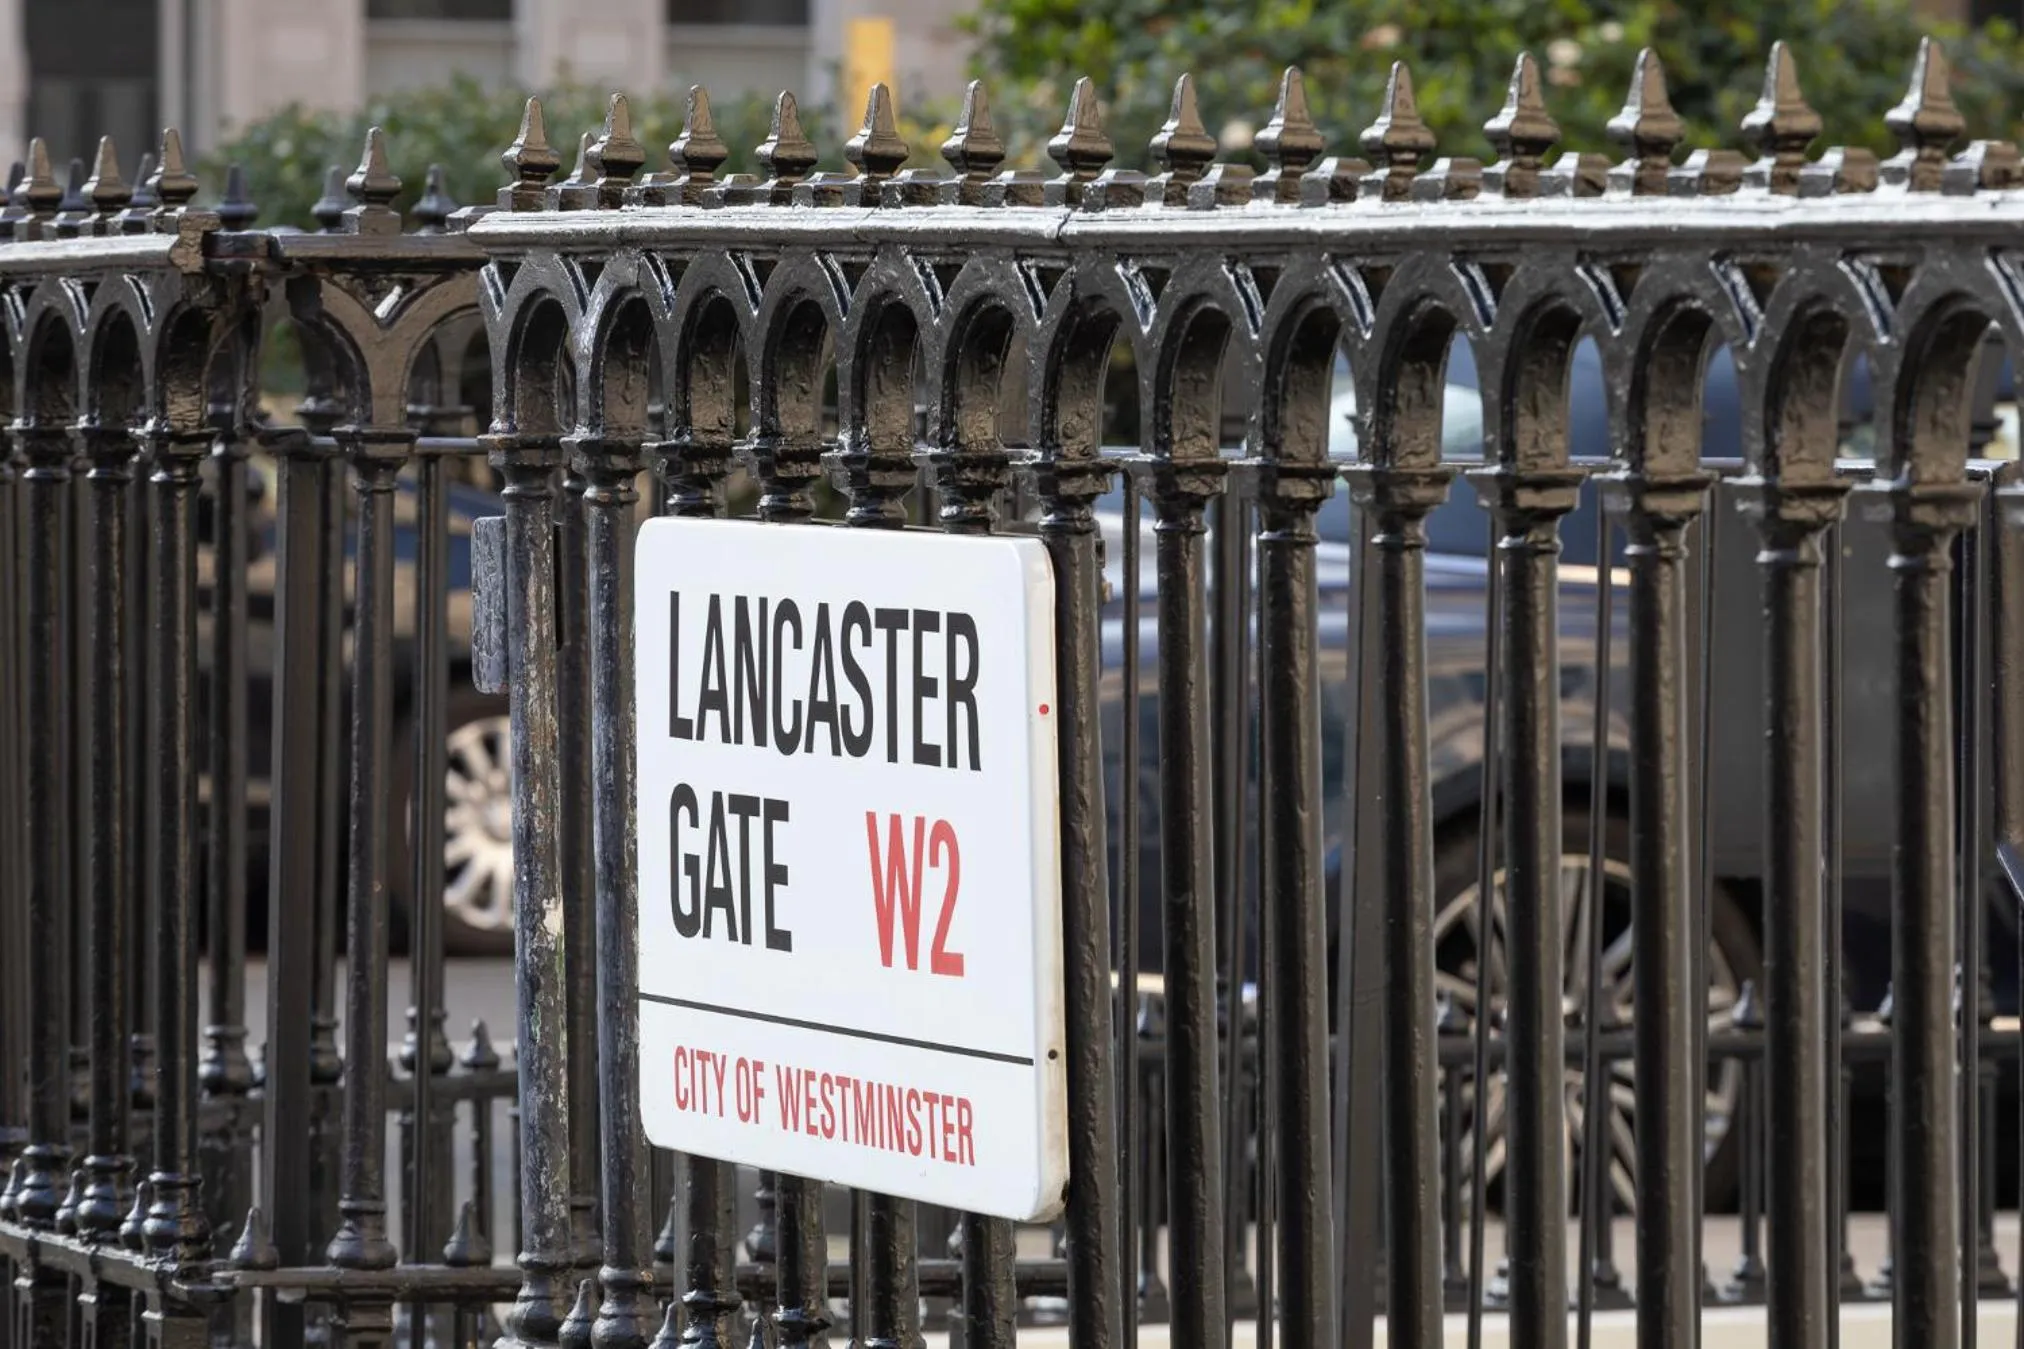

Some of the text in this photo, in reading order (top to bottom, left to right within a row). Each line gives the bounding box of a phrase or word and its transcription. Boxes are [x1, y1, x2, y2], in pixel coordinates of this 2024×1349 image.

[669, 590, 982, 772] LANCASTER
[669, 783, 965, 977] GATE W2
[674, 1046, 975, 1166] CITY OF WESTMINSTER
